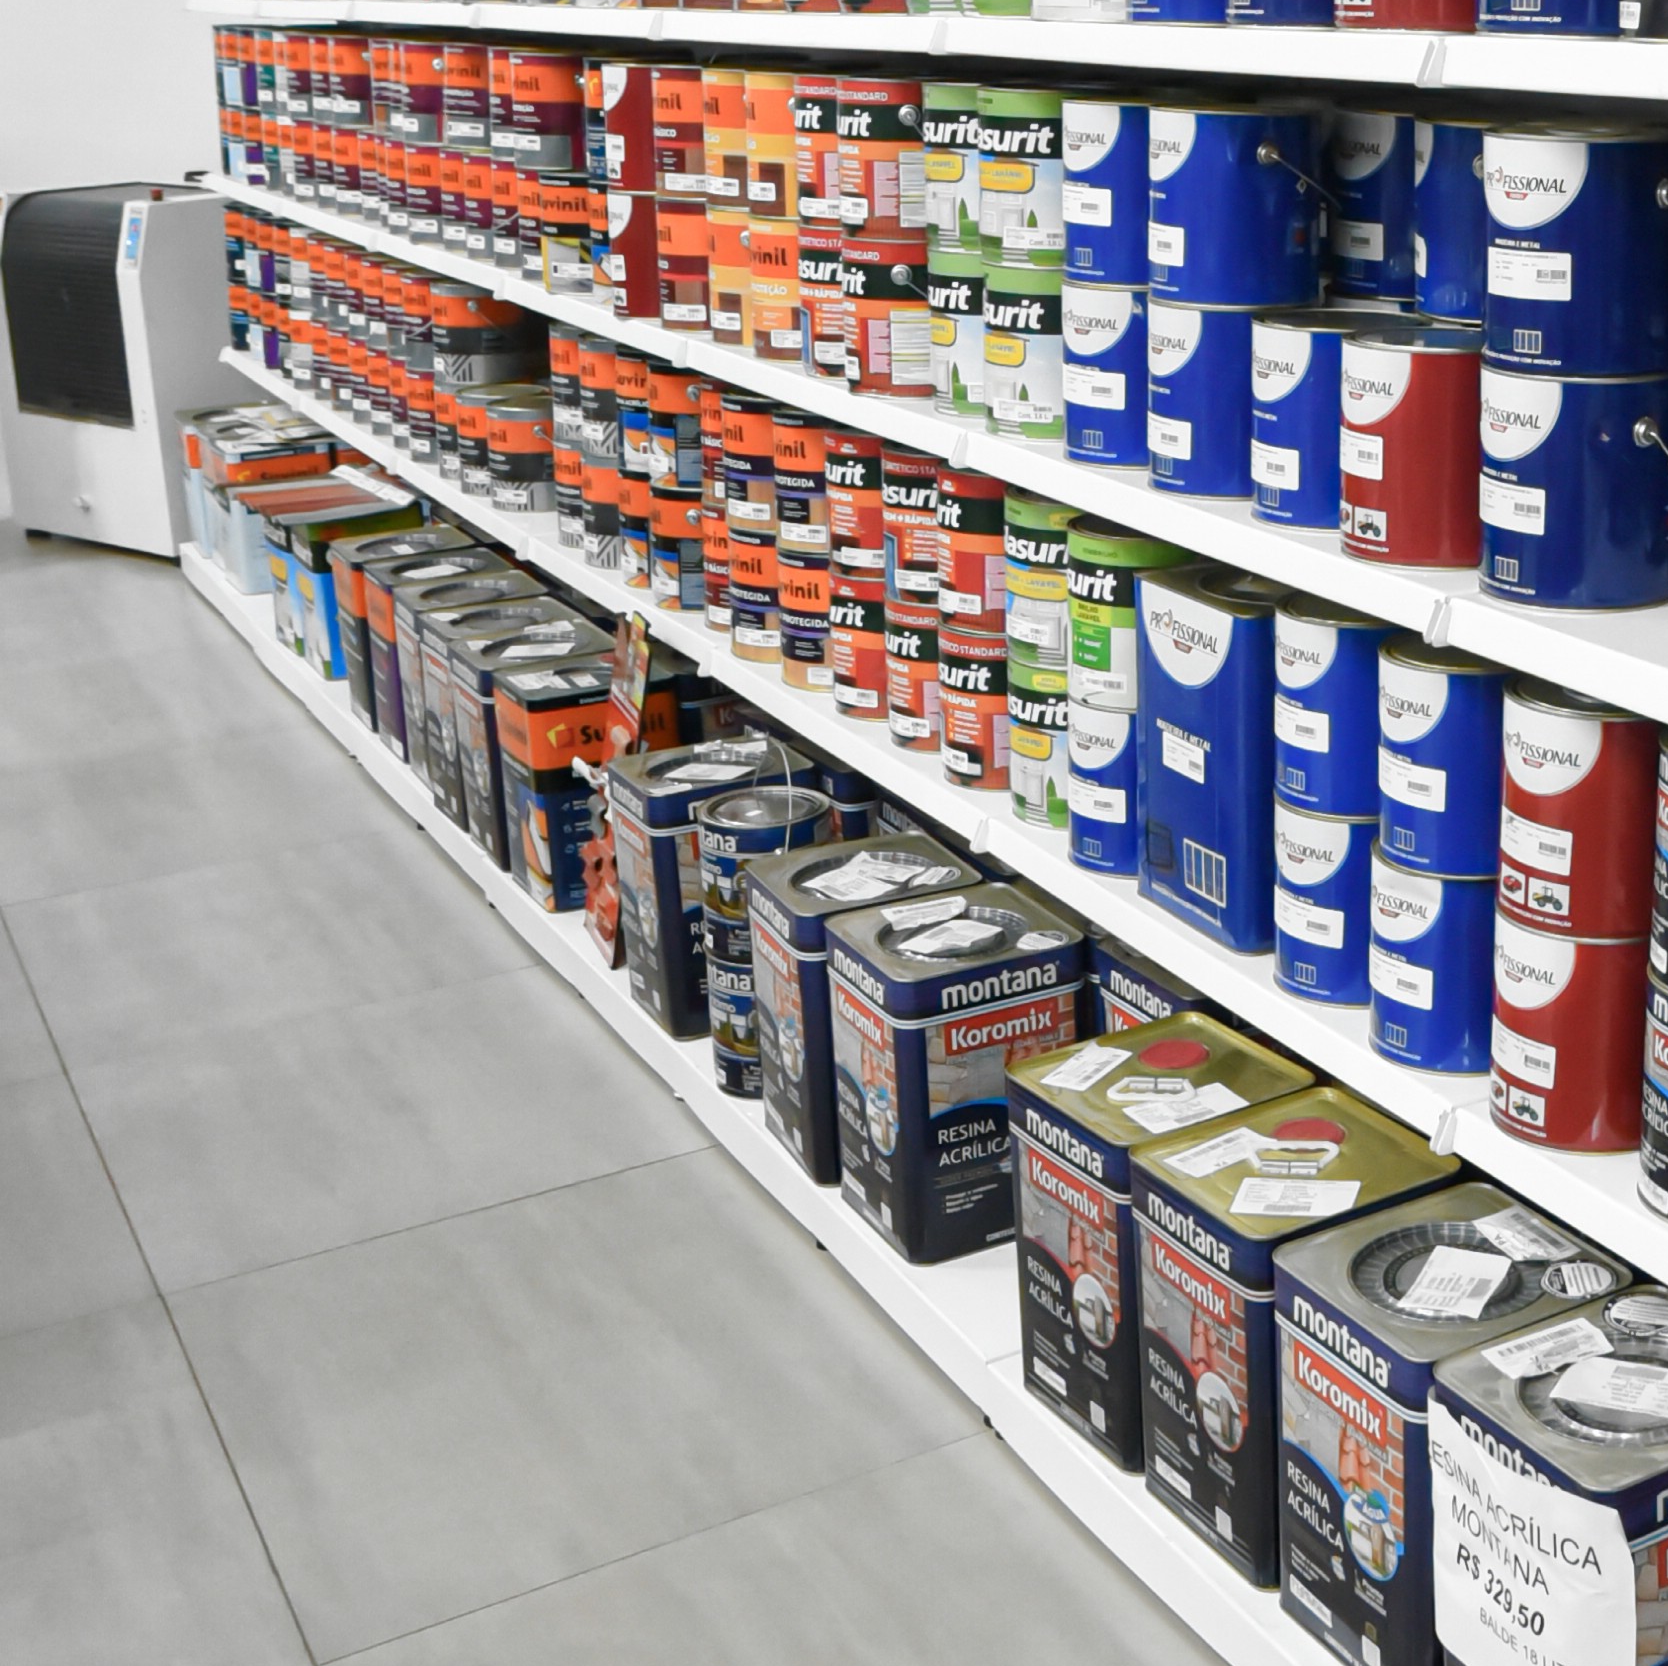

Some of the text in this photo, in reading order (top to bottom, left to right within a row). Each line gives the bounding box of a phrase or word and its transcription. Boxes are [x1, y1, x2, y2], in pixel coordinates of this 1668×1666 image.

[1149, 608, 1219, 655] PROFISSIONAL
[833, 949, 885, 1005] montana
[941, 962, 1058, 1010] montana
[950, 1008, 1053, 1051] Koromix
[938, 1117, 996, 1145] RESINA
[1026, 1107, 1103, 1178] montana
[1031, 1155, 1101, 1223] Koromix
[1148, 1191, 1231, 1272] montana
[1026, 1253, 1063, 1299] RESINA
[1155, 1239, 1226, 1319] Koromix
[1148, 1345, 1186, 1394] RESINA
[1293, 1293, 1391, 1388] montana
[1149, 1369, 1198, 1429] ACRÍLICA
[1297, 1350, 1382, 1440] Koromix
[1287, 1459, 1330, 1514] RESINA
[1429, 1441, 1604, 1576] ESINA ACRÍLICA
[1286, 1489, 1345, 1553] ACRÍLICA
[1451, 1495, 1550, 1596] MONTANA
[1455, 1541, 1545, 1637] R$ 329,50
[1479, 1606, 1519, 1654] BALDE
[1523, 1644, 1539, 1666] 18
